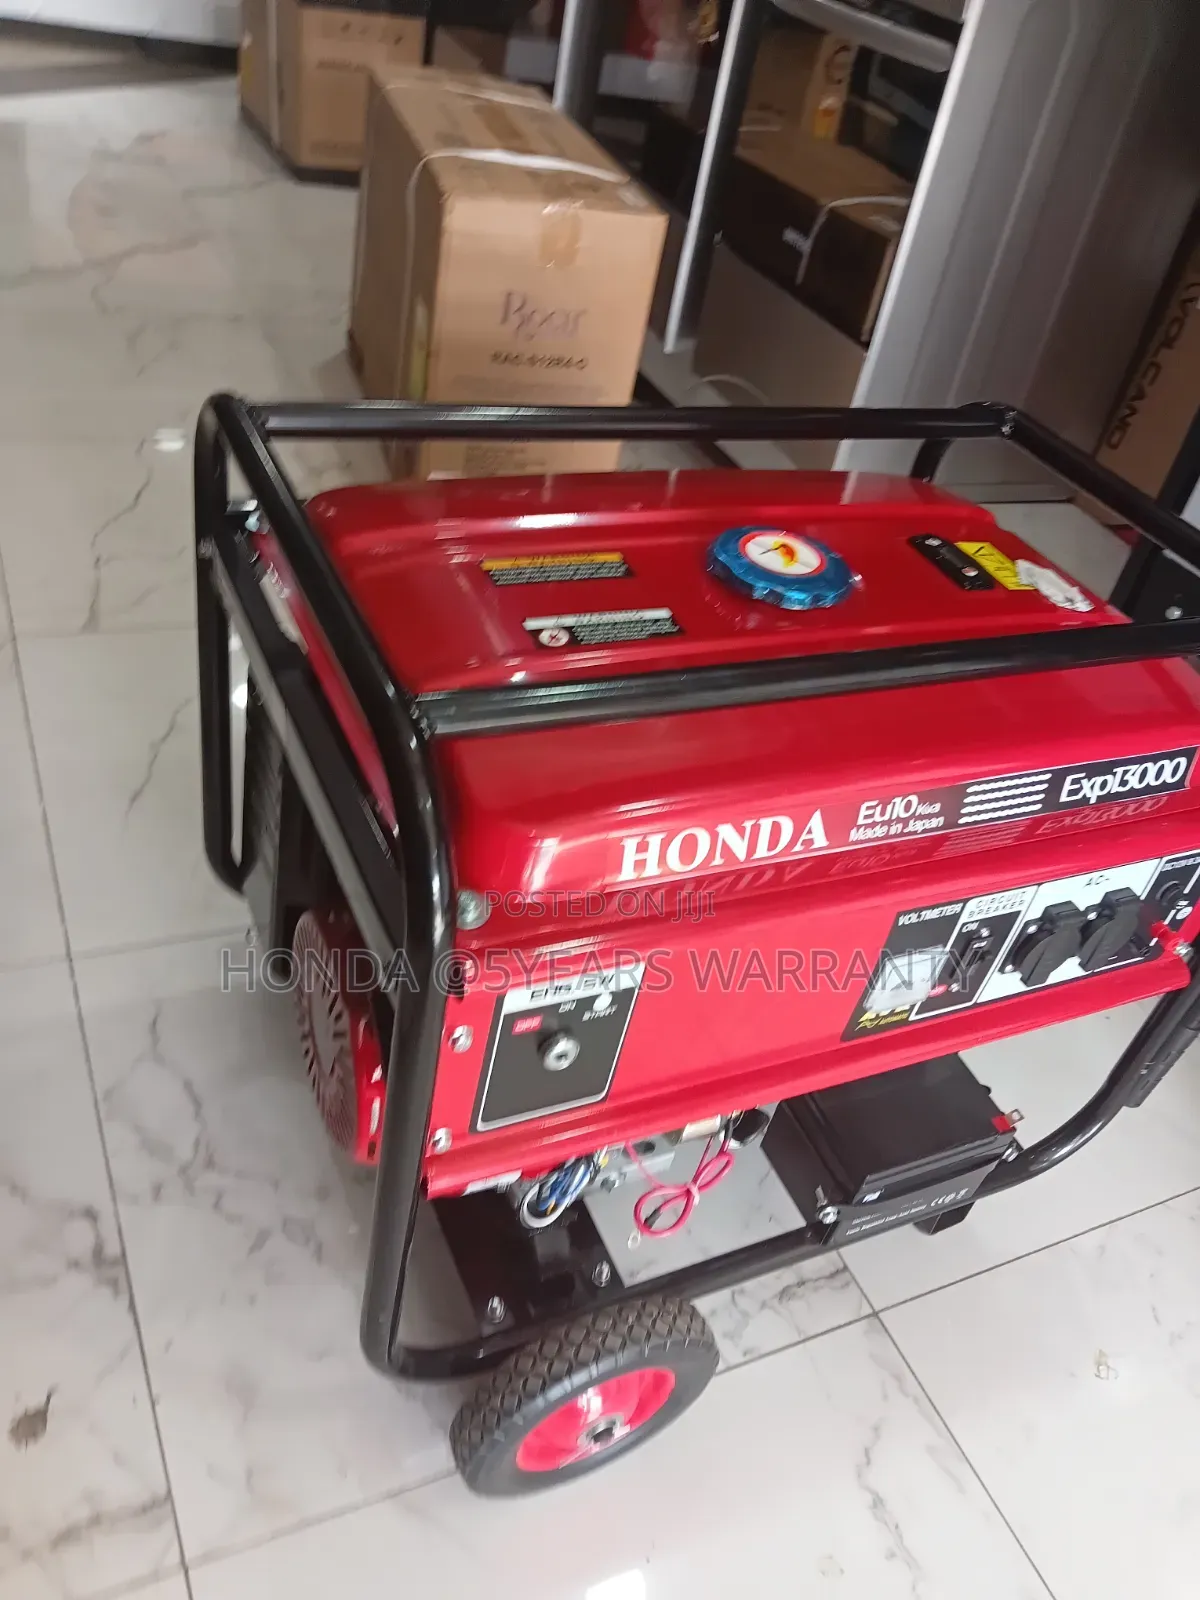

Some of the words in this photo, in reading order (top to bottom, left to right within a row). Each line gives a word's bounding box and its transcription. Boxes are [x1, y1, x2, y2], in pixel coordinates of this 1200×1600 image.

[849, 824, 888, 842] Made
[889, 821, 903, 835] in
[903, 816, 945, 833] Japan
[615, 808, 830, 882] HONDA
[898, 902, 964, 927] VOLTMETER
[967, 899, 1026, 919] BREAKER
